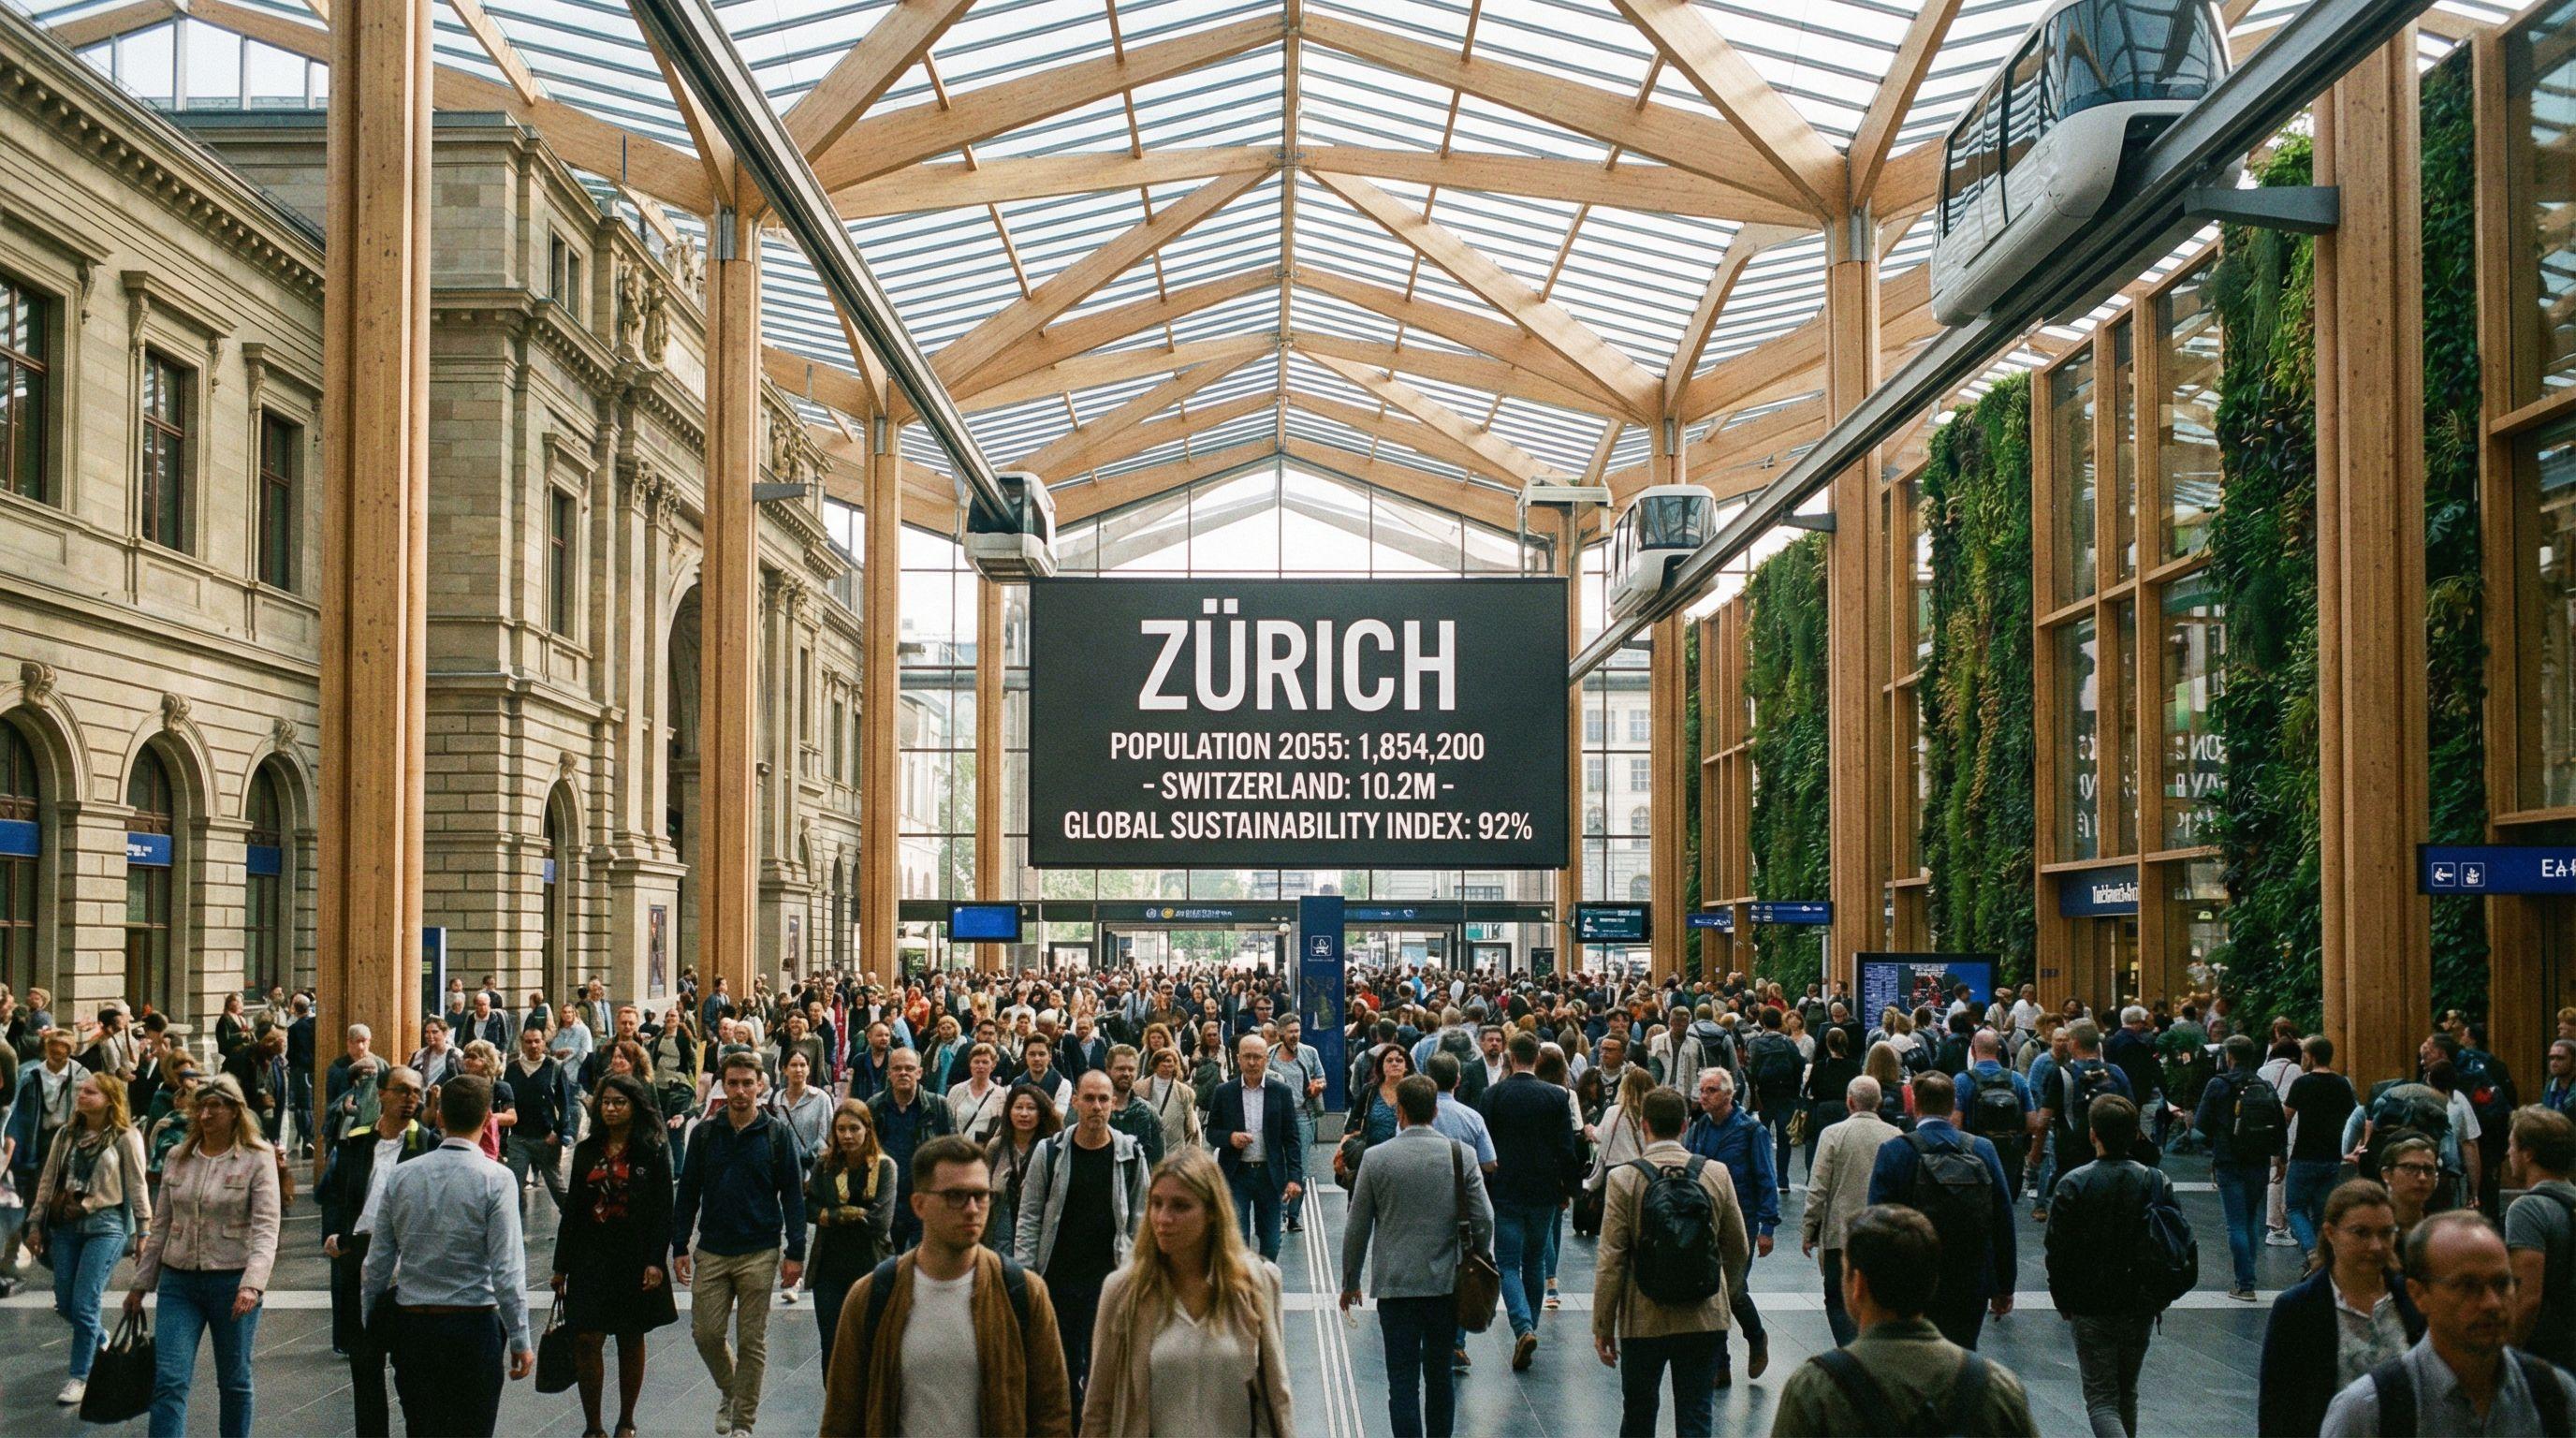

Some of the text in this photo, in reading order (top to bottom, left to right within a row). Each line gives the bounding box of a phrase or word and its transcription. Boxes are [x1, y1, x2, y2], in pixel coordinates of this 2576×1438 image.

[1139, 598, 1456, 712] ZÜRICH
[1111, 732, 1485, 766] POPULATION 2055: 1,854,200
[1162, 771, 1351, 800] SWITZERLAND:
[1360, 771, 1436, 800] 10.2M
[1064, 812, 1532, 841] GLOBAL SUSTAINABILITY INDEX: 92%
